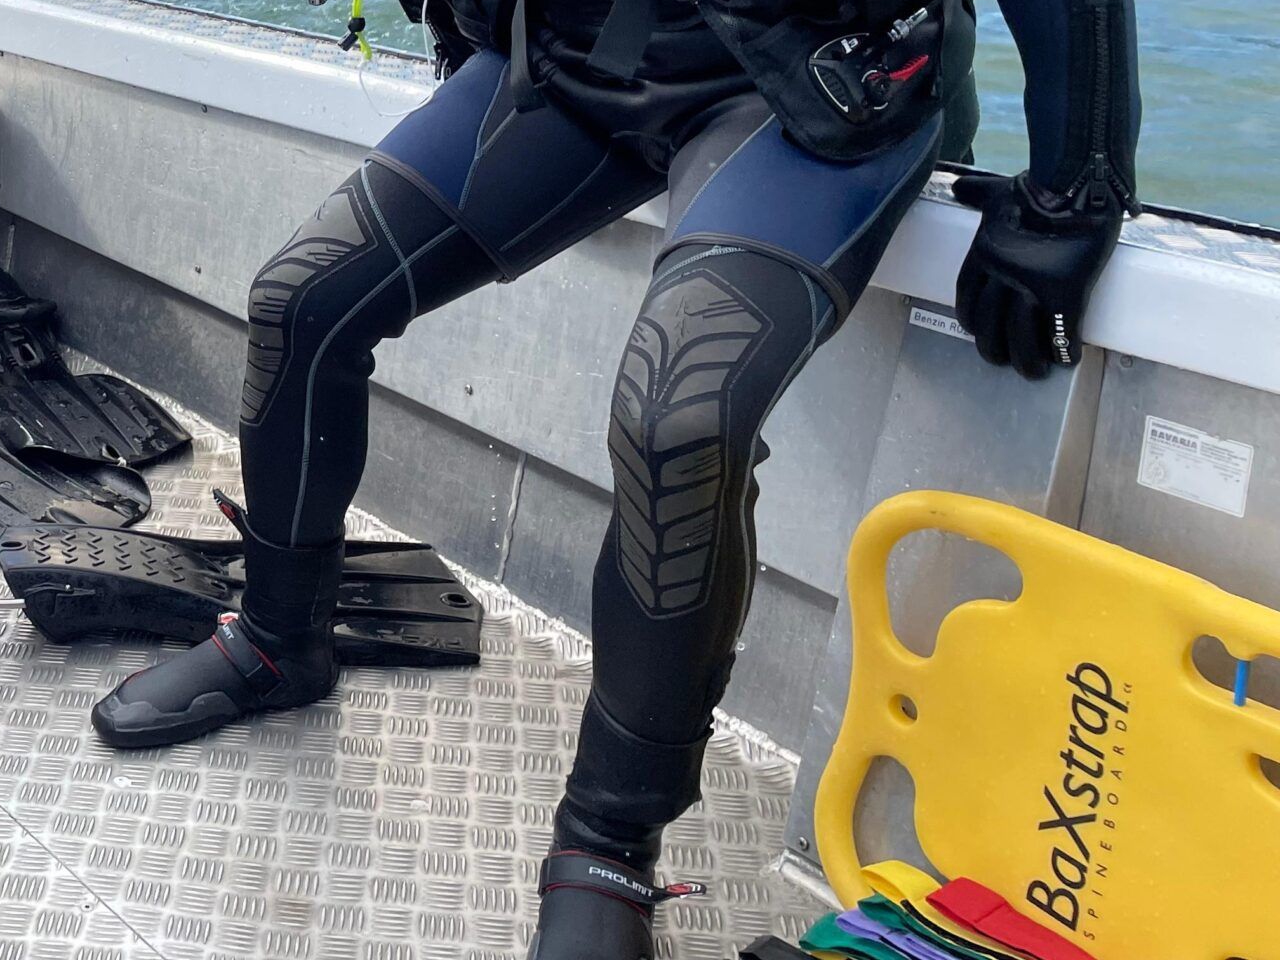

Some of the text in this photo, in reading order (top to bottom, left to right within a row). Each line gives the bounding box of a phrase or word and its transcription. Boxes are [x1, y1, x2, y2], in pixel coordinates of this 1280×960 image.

[914, 311, 946, 329] Benzin
[1150, 428, 1198, 449] BAVARIA
[1025, 661, 1129, 932] BaXstrap
[1083, 719, 1128, 941] SPINEBOARD
[588, 866, 654, 897] PROLIMIT
